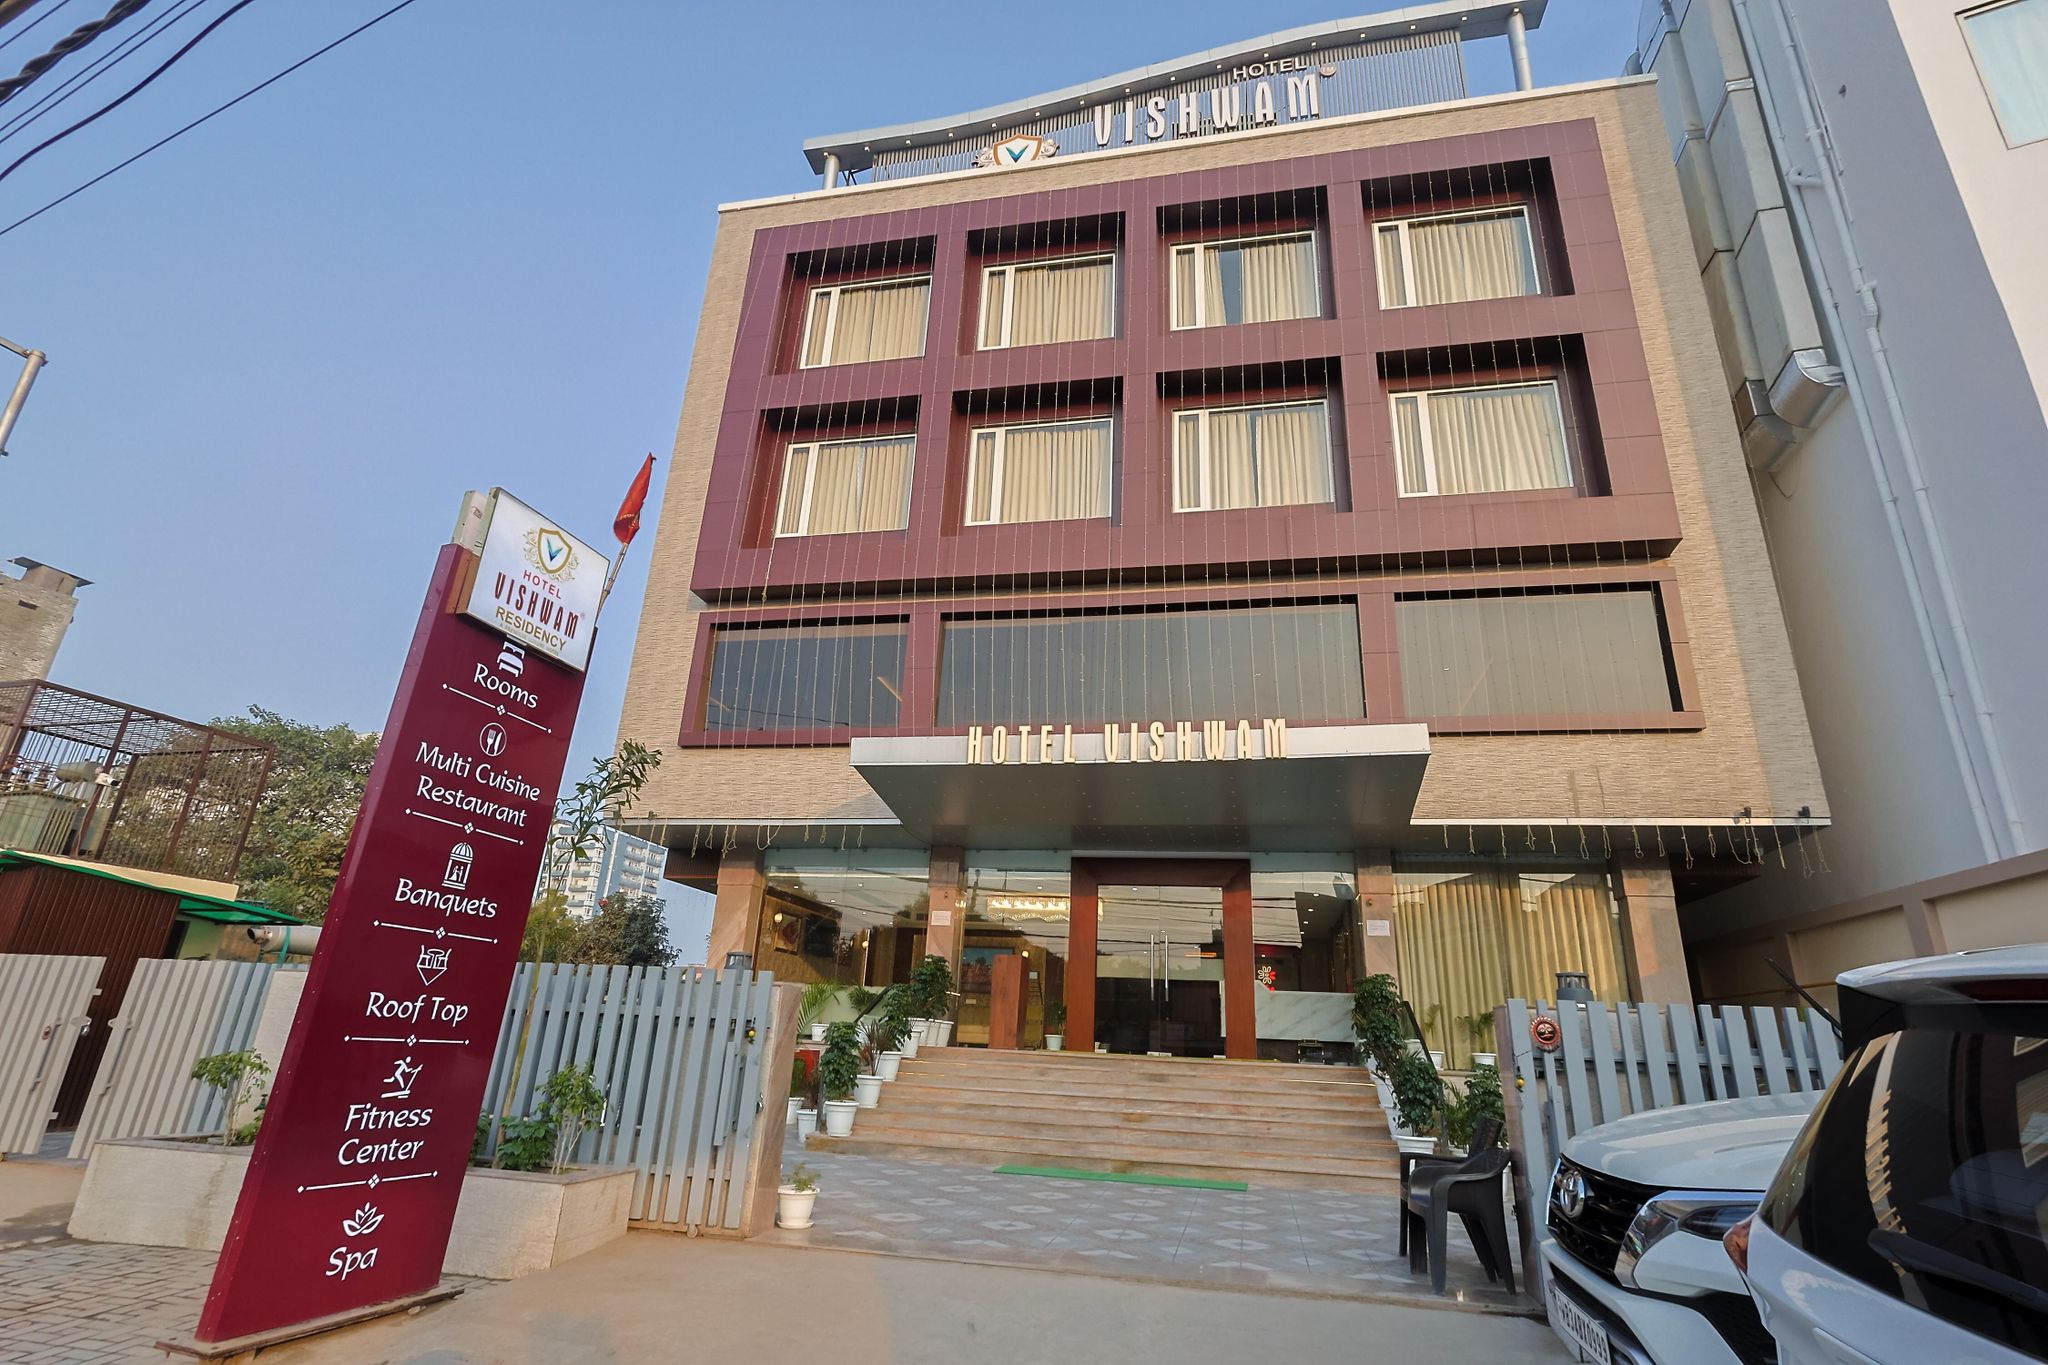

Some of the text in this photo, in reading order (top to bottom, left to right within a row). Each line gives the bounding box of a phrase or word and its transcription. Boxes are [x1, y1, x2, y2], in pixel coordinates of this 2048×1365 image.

[1233, 57, 1308, 80] HOTEL
[1094, 74, 1320, 146] VISHWAM
[494, 572, 579, 640] VISHWAM
[523, 570, 562, 600] HOTEL
[495, 606, 567, 651] RESIDENCY
[473, 662, 538, 709] Rooms
[967, 718, 1288, 765] HOTEL VISHWAM
[415, 741, 541, 801] Multi Cuisine
[416, 775, 528, 827] Restaurant
[394, 878, 498, 918] Banquets
[365, 991, 469, 1027] Roof Top
[344, 1103, 433, 1132] Fitness
[337, 1138, 425, 1166] Center
[325, 1246, 379, 1281] Spa
